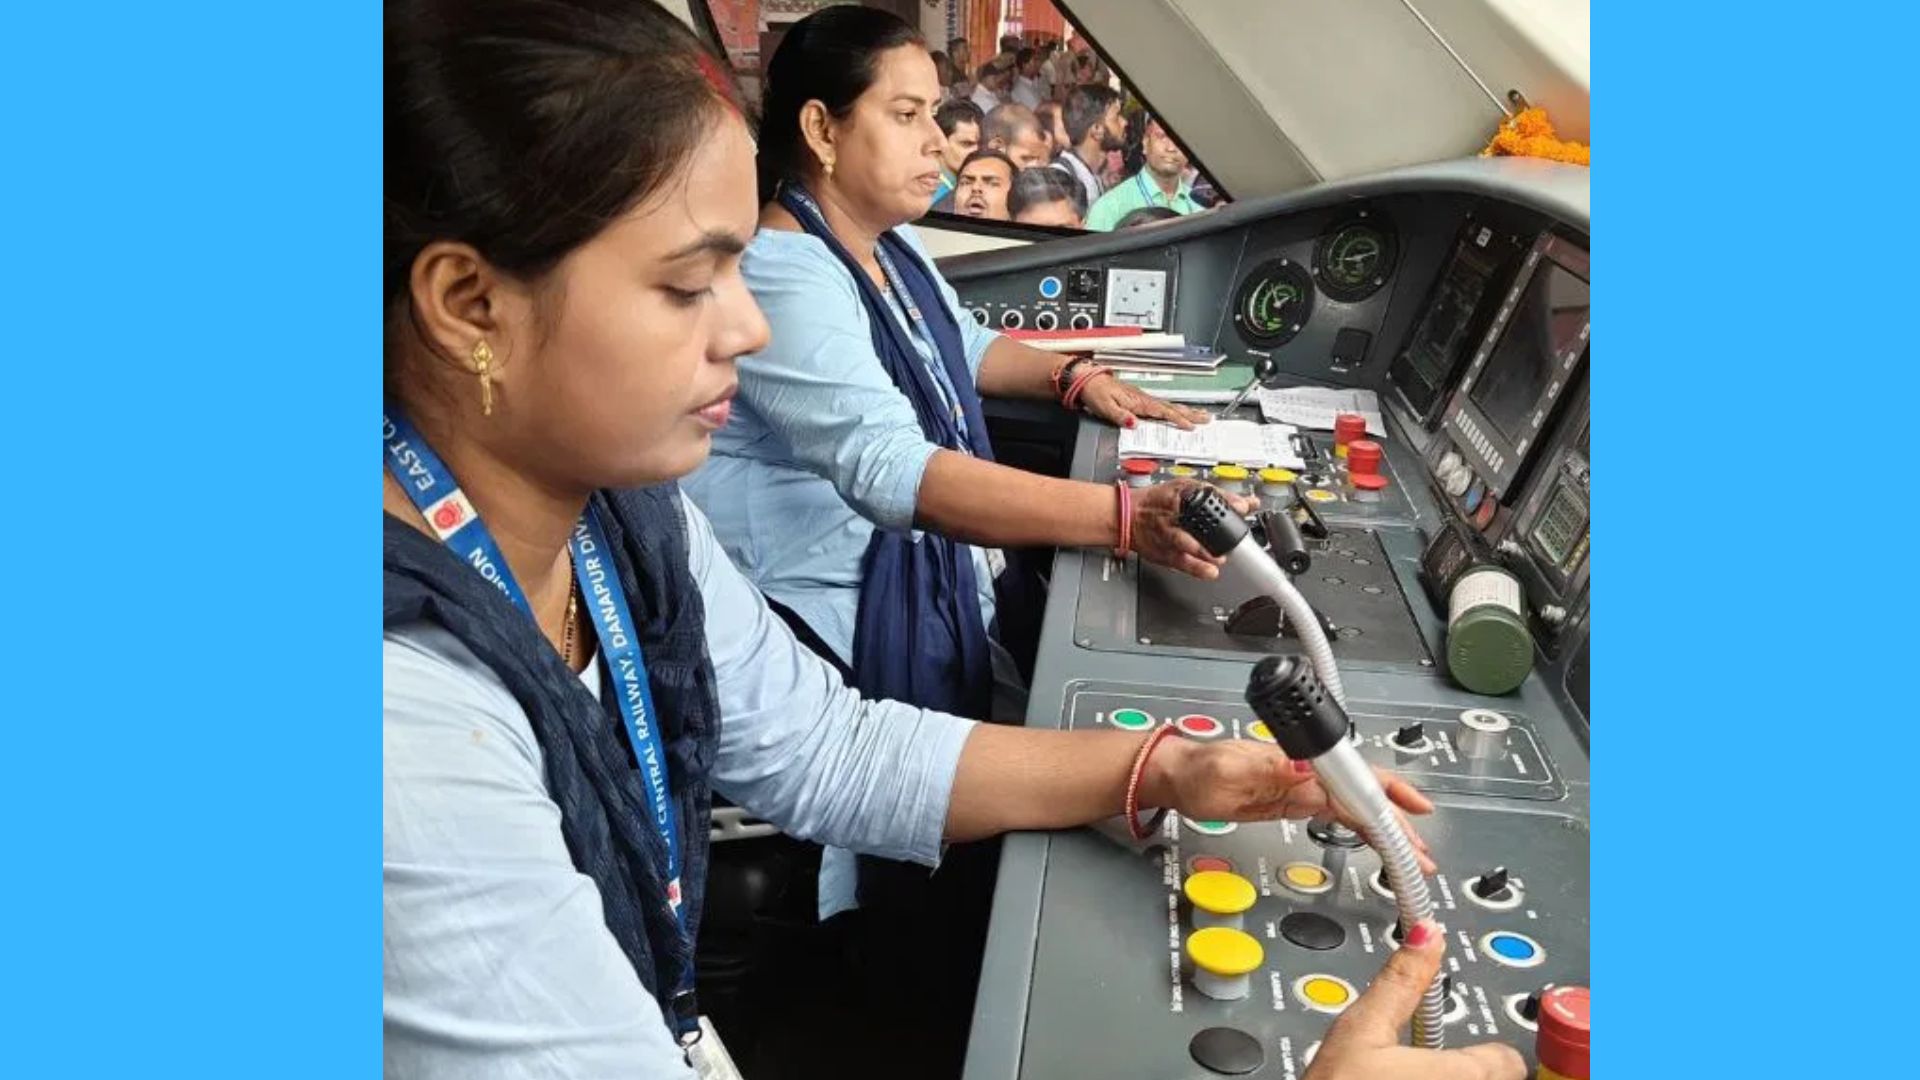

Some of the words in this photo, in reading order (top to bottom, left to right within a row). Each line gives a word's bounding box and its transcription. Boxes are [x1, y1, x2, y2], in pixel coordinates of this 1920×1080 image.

[389, 441, 436, 491] EAST
[585, 557, 628, 648] DANAPUR
[643, 742, 668, 824] CENTRAL
